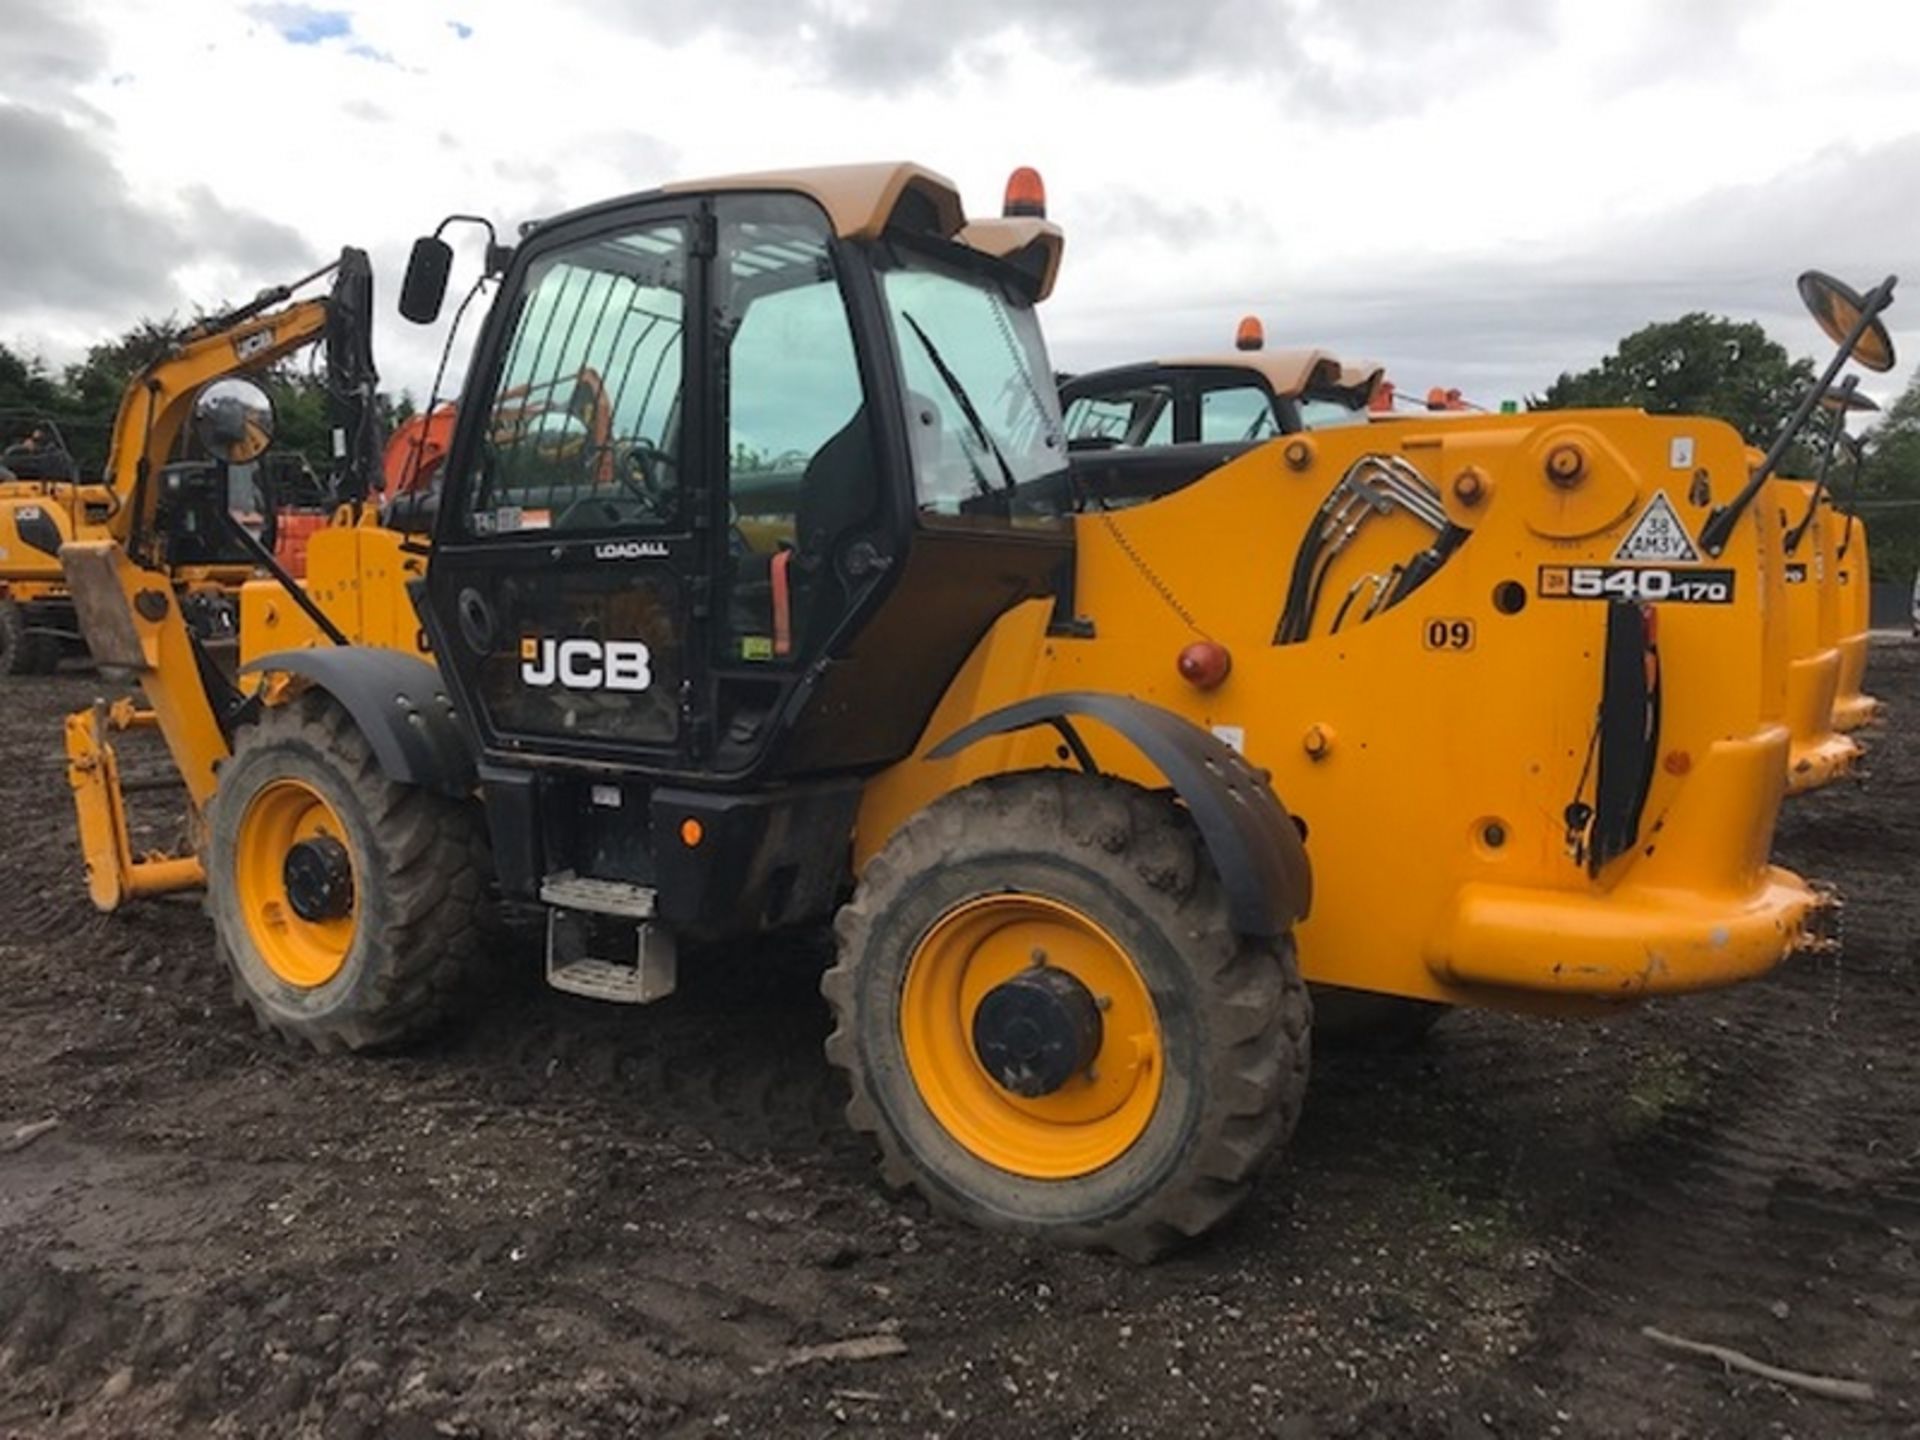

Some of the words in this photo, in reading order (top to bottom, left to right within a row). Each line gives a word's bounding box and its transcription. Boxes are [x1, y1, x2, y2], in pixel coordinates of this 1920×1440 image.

[1646, 518, 1669, 534] 38
[595, 542, 669, 559] LOADALL
[1429, 621, 1470, 648] 09
[521, 639, 650, 690] JCB
